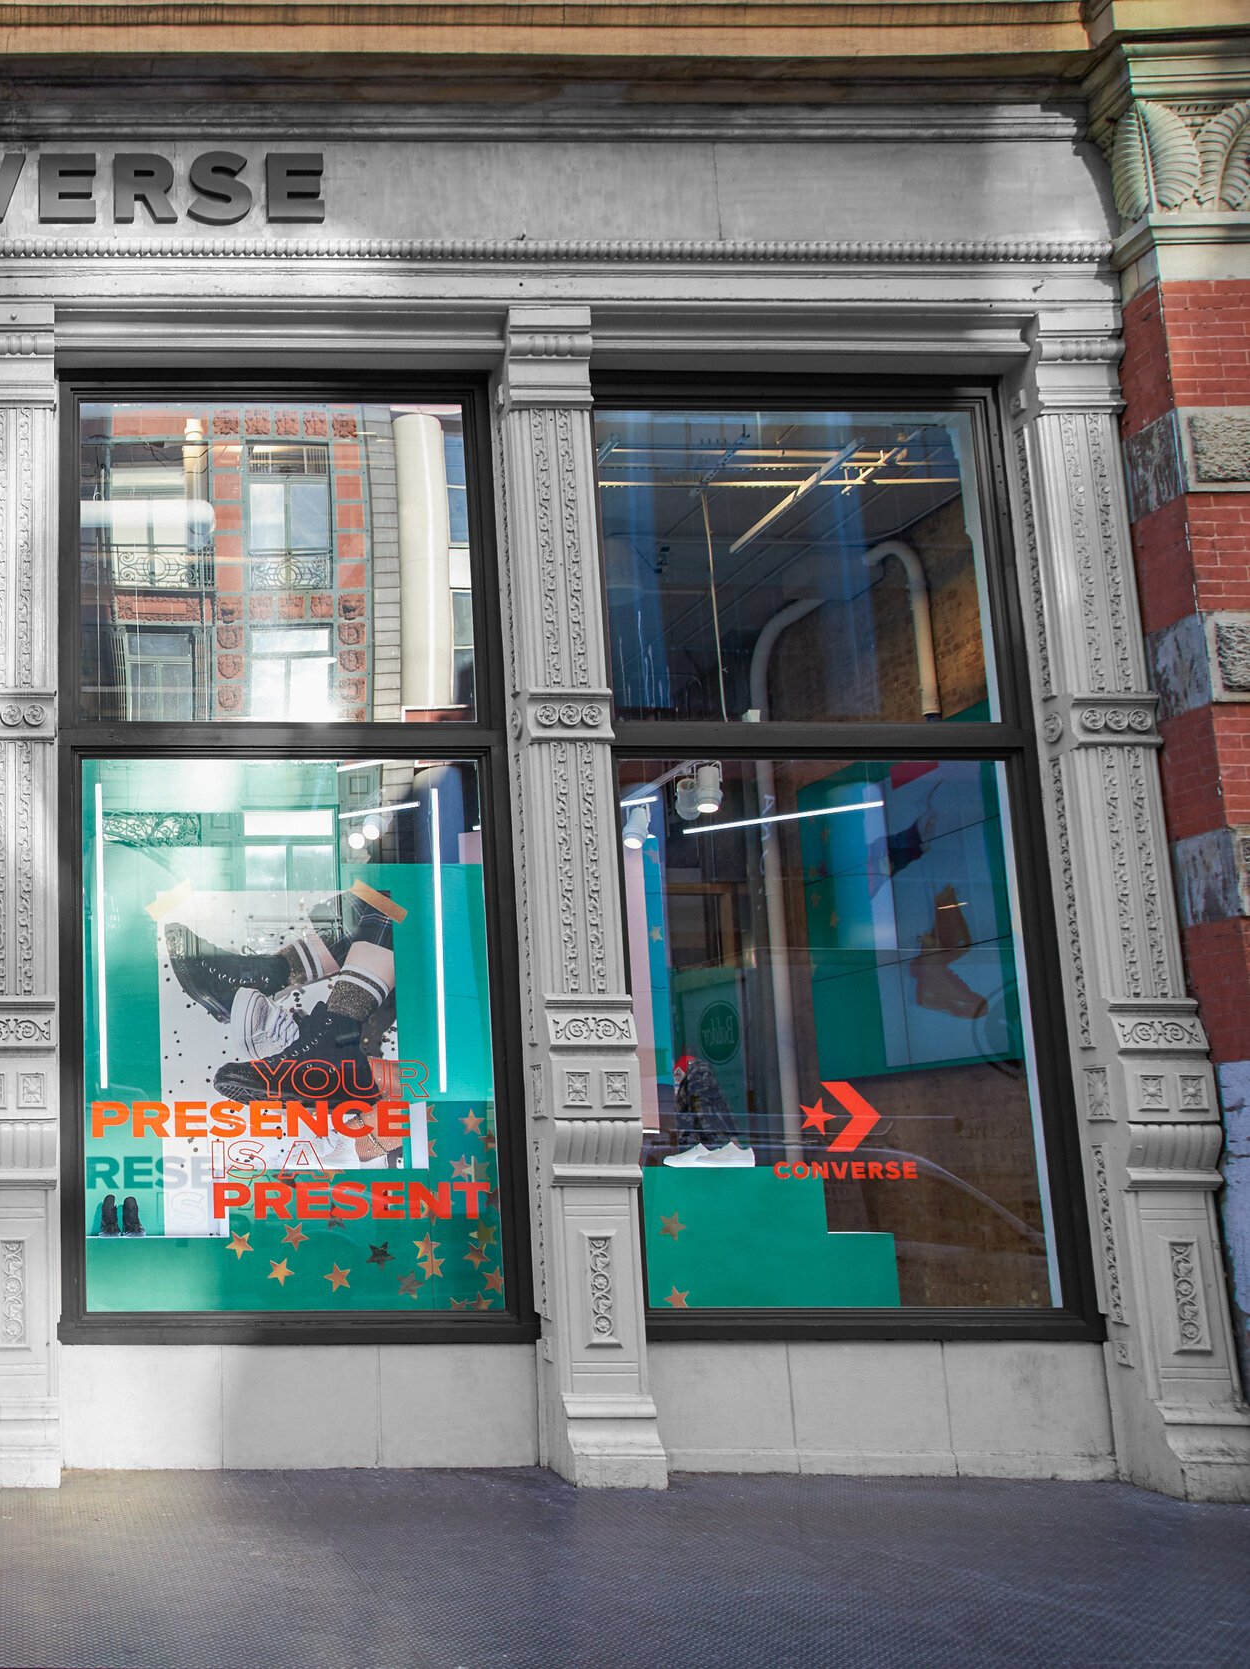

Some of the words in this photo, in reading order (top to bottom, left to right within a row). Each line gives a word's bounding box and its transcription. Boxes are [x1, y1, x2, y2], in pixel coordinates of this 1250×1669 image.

[250, 1059, 430, 1099] YOUR
[91, 1100, 411, 1138] PRESENCE
[211, 1140, 265, 1180] IS
[279, 1140, 330, 1180] A
[773, 1160, 919, 1180] CONVERSE
[212, 1177, 490, 1220] PRESENT
